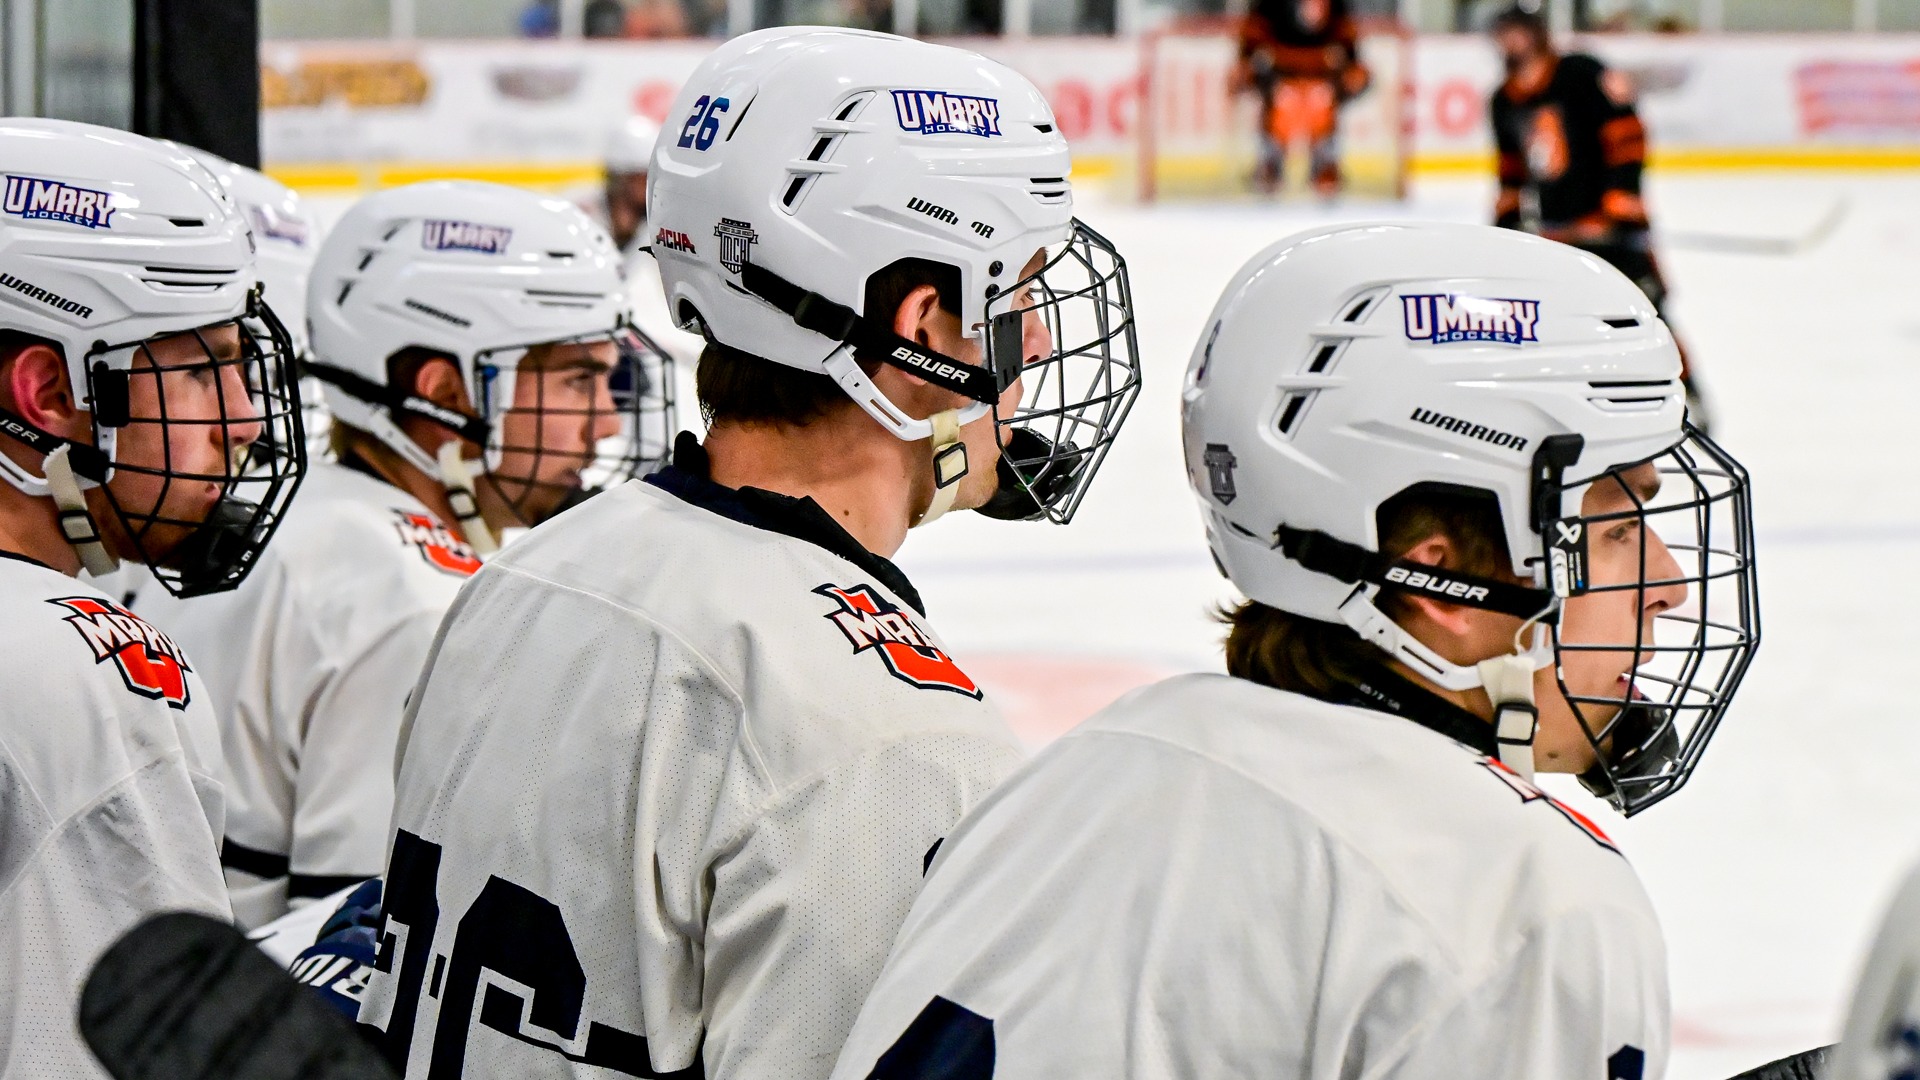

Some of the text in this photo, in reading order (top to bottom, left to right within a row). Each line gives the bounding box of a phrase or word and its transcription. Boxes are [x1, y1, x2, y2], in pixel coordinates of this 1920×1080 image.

[677, 95, 730, 152] 26
[26, 210, 94, 227] HOCKEY
[656, 227, 697, 254] ACHA
[0, 272, 93, 319] WARRIOR
[1435, 330, 1518, 343] HOCKEY
[1409, 407, 1529, 451] WARRIOR
